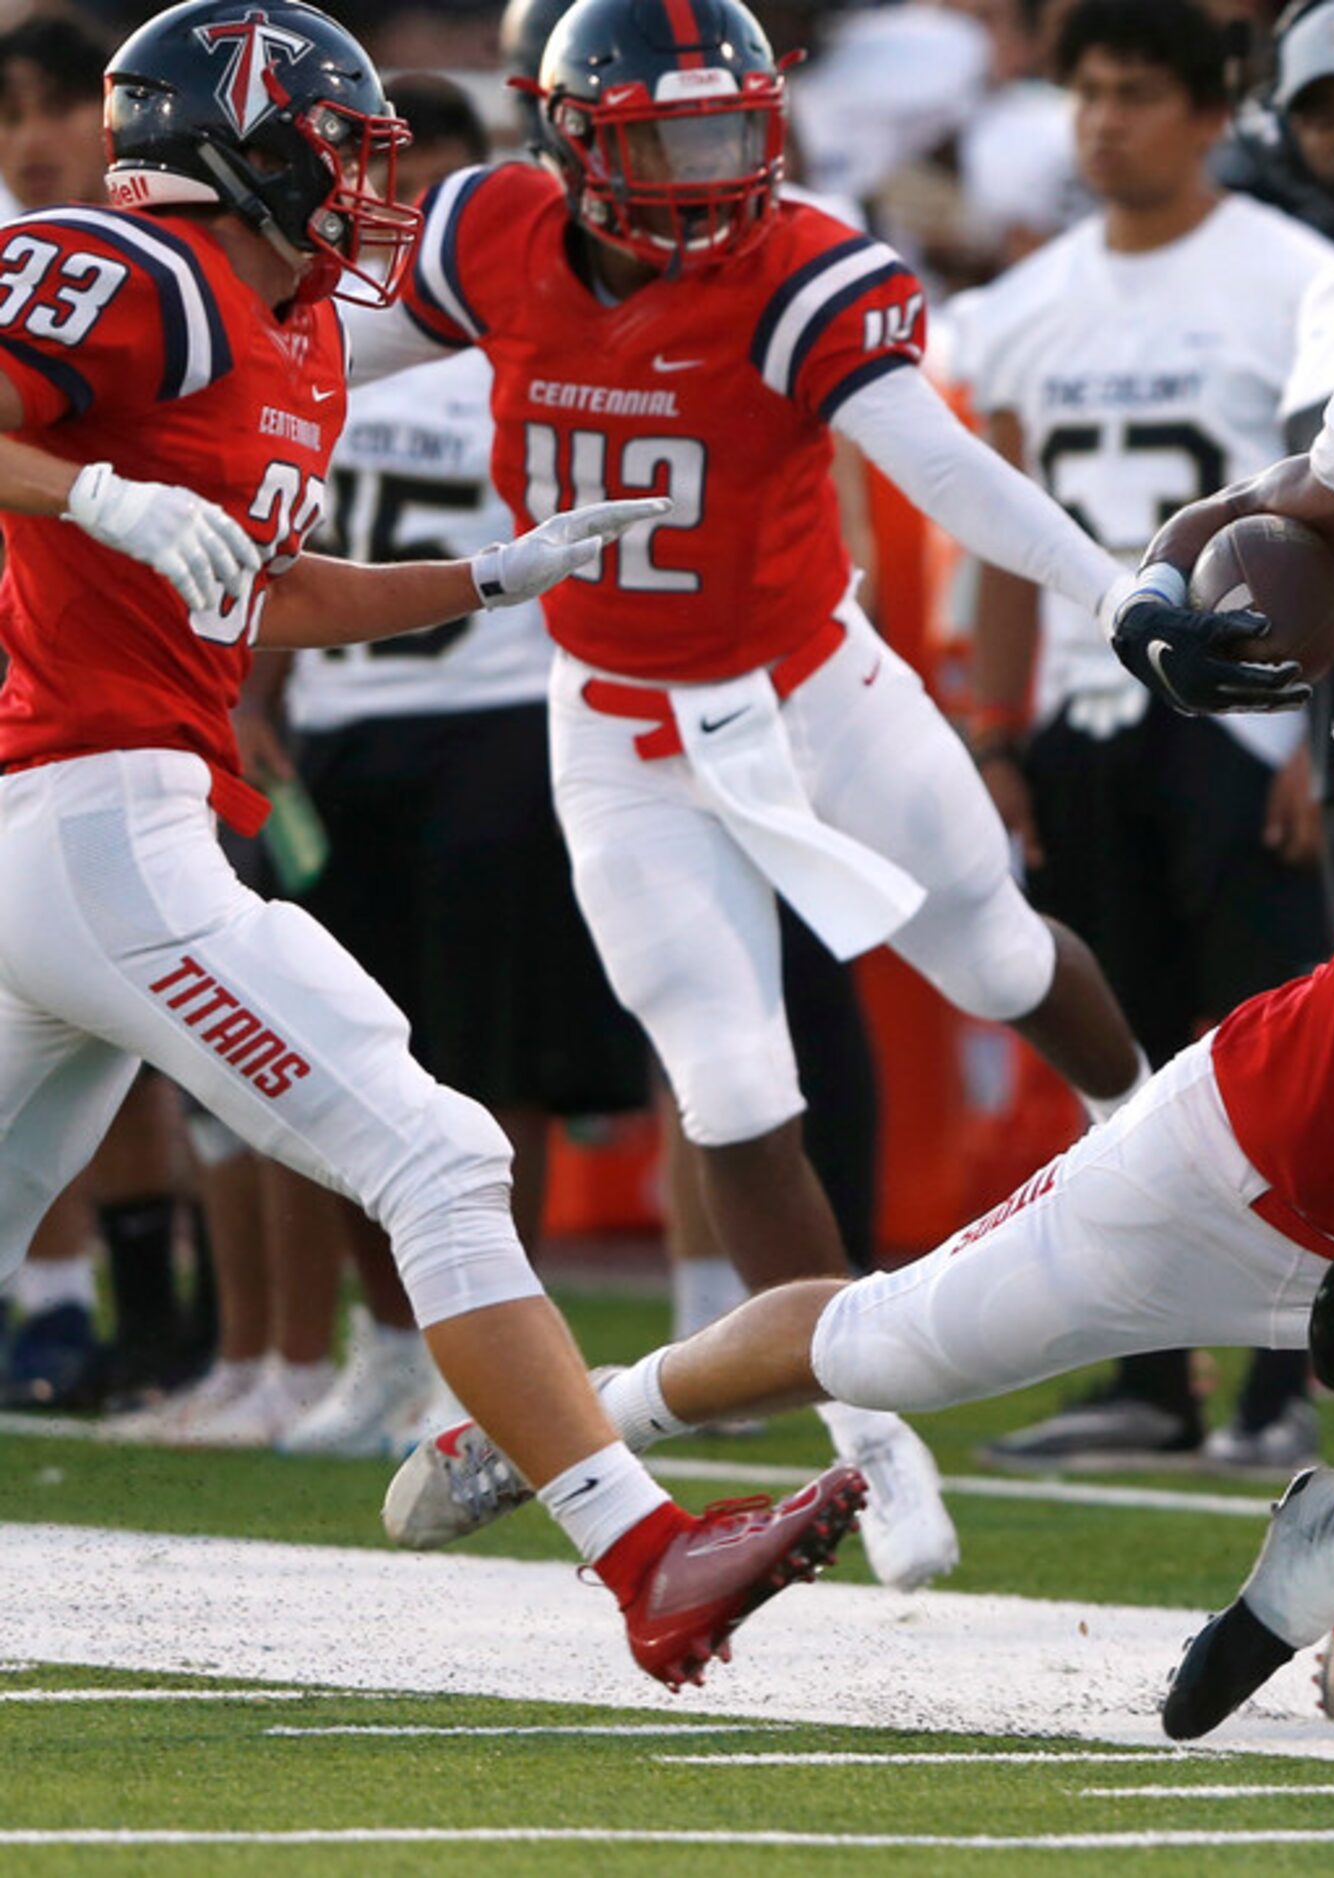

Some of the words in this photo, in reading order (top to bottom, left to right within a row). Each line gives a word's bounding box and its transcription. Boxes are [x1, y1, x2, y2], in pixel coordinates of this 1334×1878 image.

[0, 233, 130, 347] 33
[528, 379, 681, 418] CENTENNIAL
[147, 954, 312, 1099] TITANS
